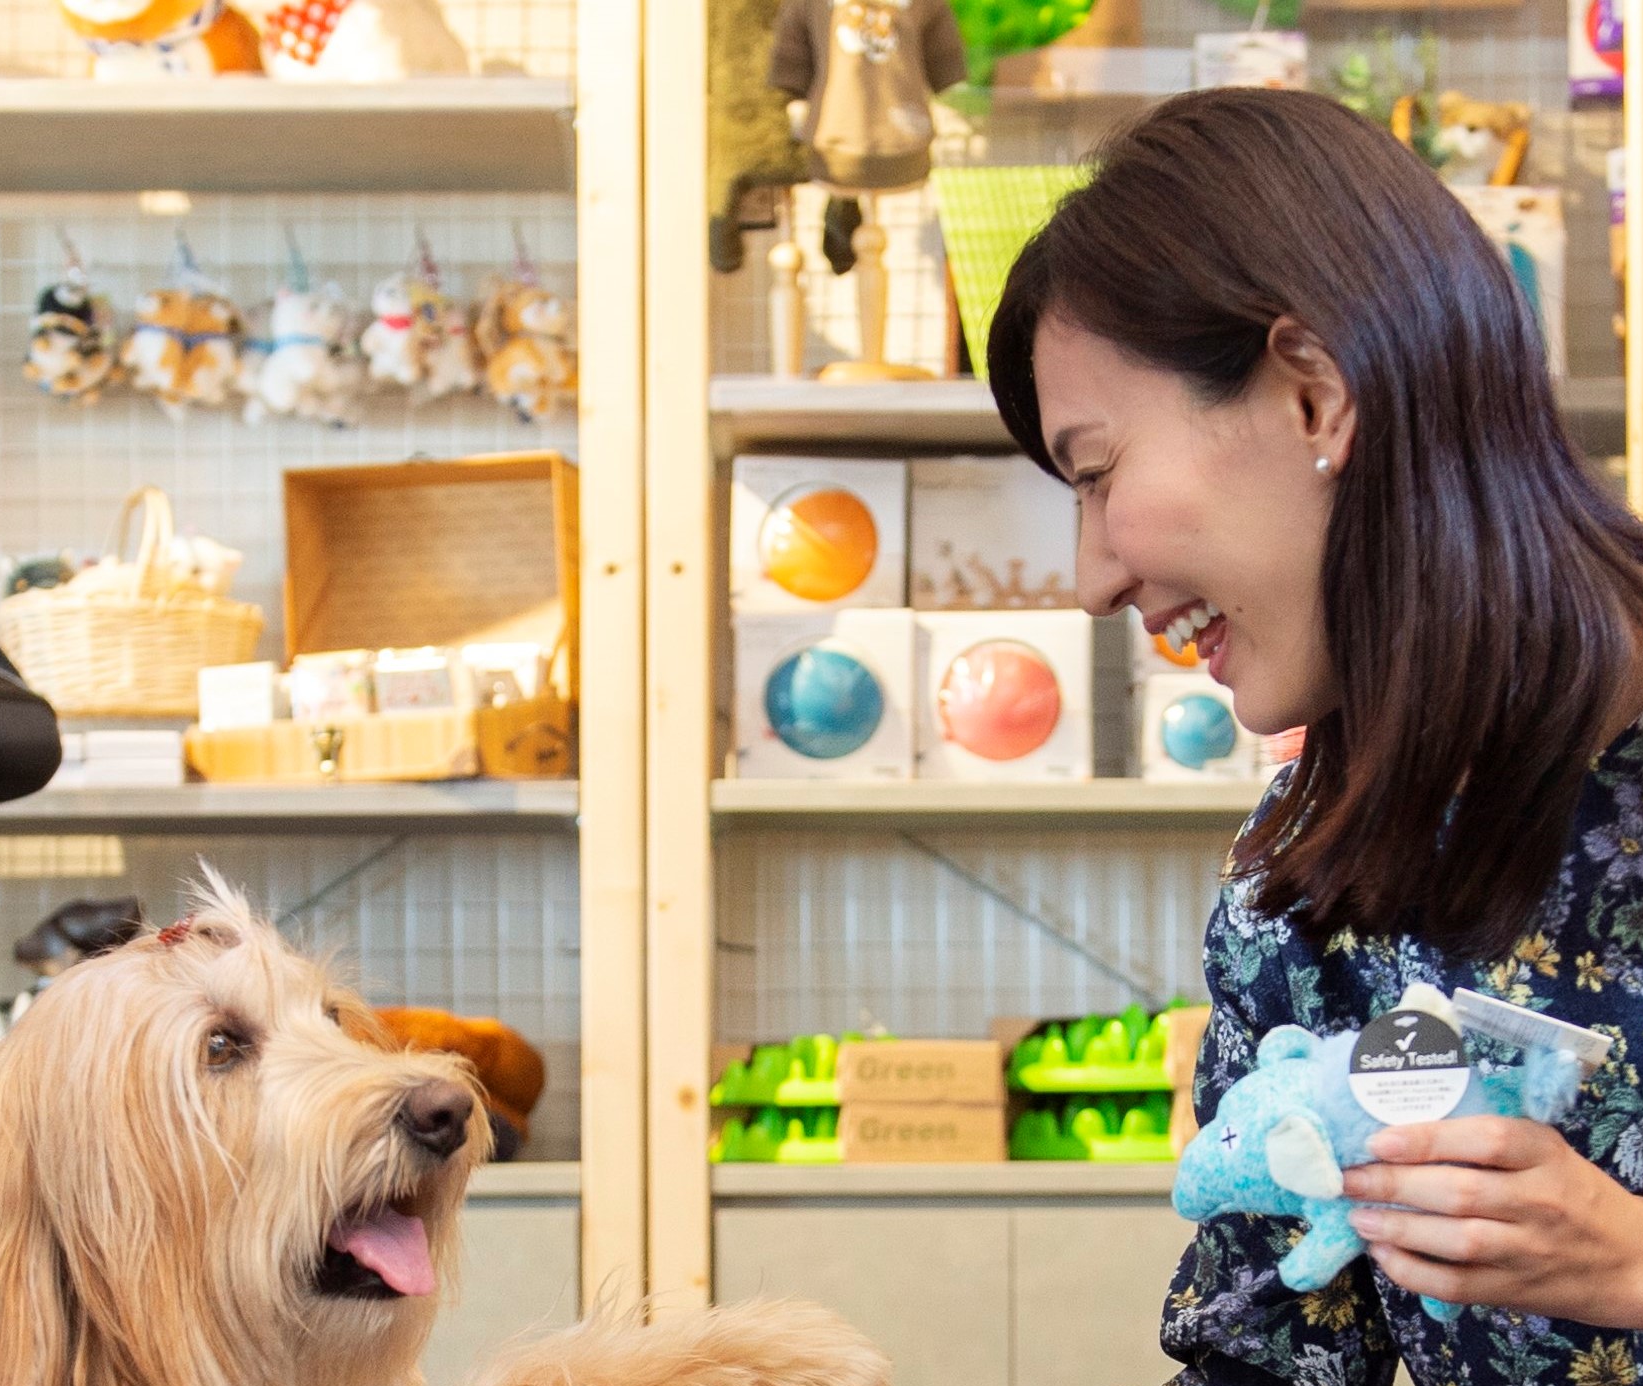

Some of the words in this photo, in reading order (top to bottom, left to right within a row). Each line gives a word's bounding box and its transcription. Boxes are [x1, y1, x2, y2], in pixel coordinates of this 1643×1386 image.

[856, 1056, 957, 1082] Green
[1359, 1051, 1406, 1070] Safety
[1406, 1049, 1459, 1067] Tested!
[858, 1117, 958, 1142] Green
